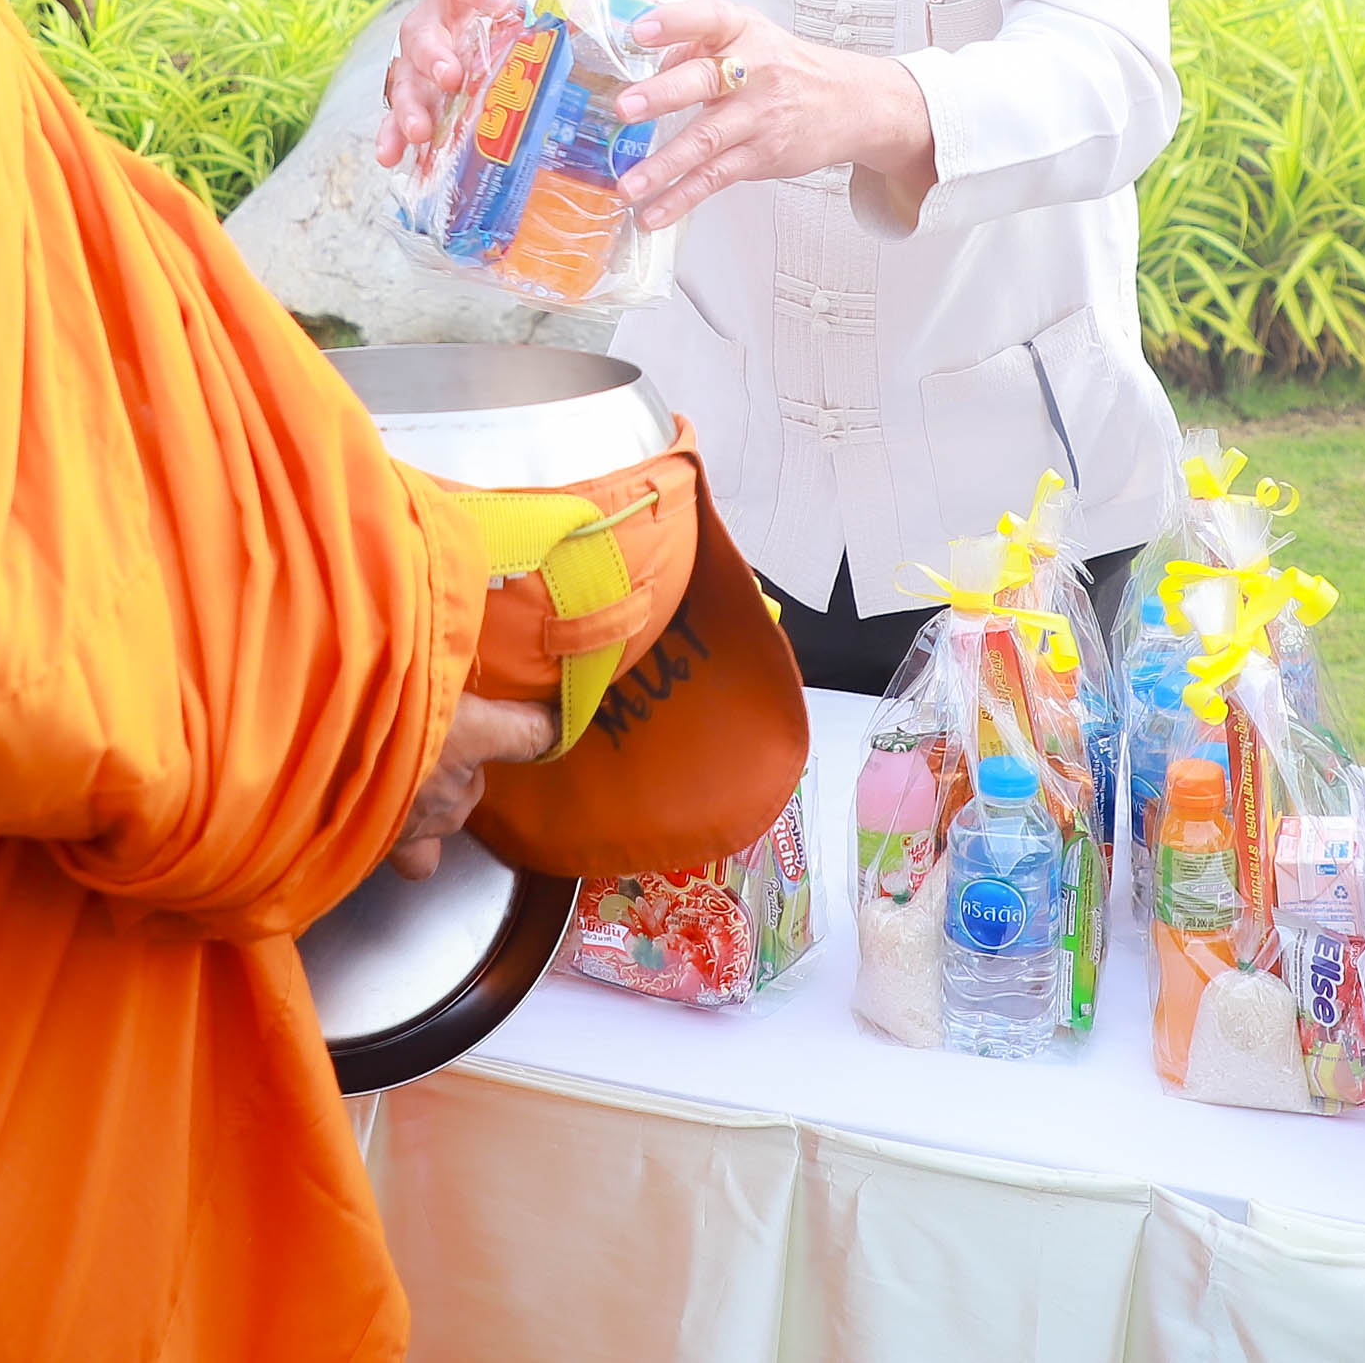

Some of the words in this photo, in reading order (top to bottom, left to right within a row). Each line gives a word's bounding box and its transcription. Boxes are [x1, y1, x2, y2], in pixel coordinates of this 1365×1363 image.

[777, 816, 797, 877] Richs
[962, 900, 1022, 927] คริสตัล
[1310, 934, 1344, 1024] Ellse
